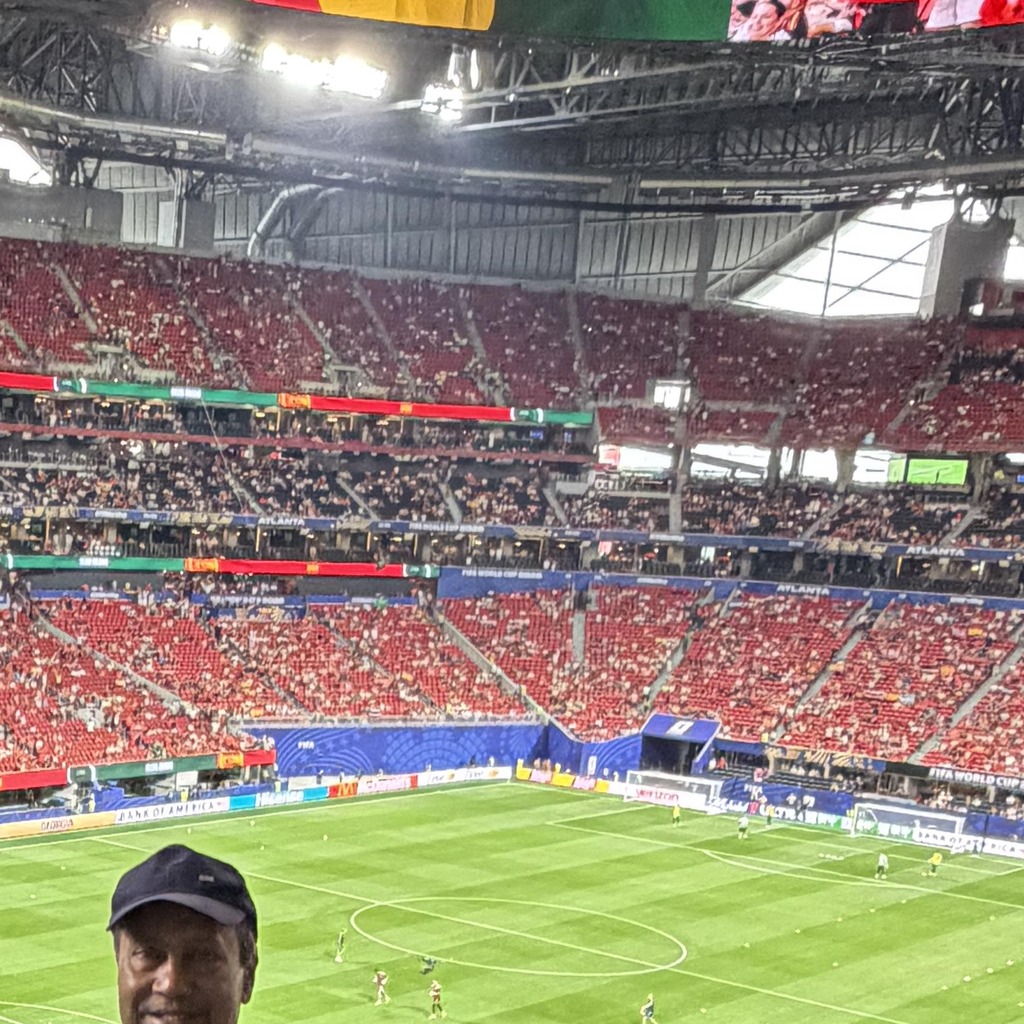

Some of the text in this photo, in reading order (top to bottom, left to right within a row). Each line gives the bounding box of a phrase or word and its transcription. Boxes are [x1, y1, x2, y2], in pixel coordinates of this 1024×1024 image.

[258, 517, 304, 526] ATLANTA
[906, 547, 965, 556] ATLANTA
[776, 585, 829, 595] ATLANTA
[929, 767, 1020, 788] FIFA WORLD CUP
[118, 810, 148, 821] BANK
[153, 807, 164, 816] OF
